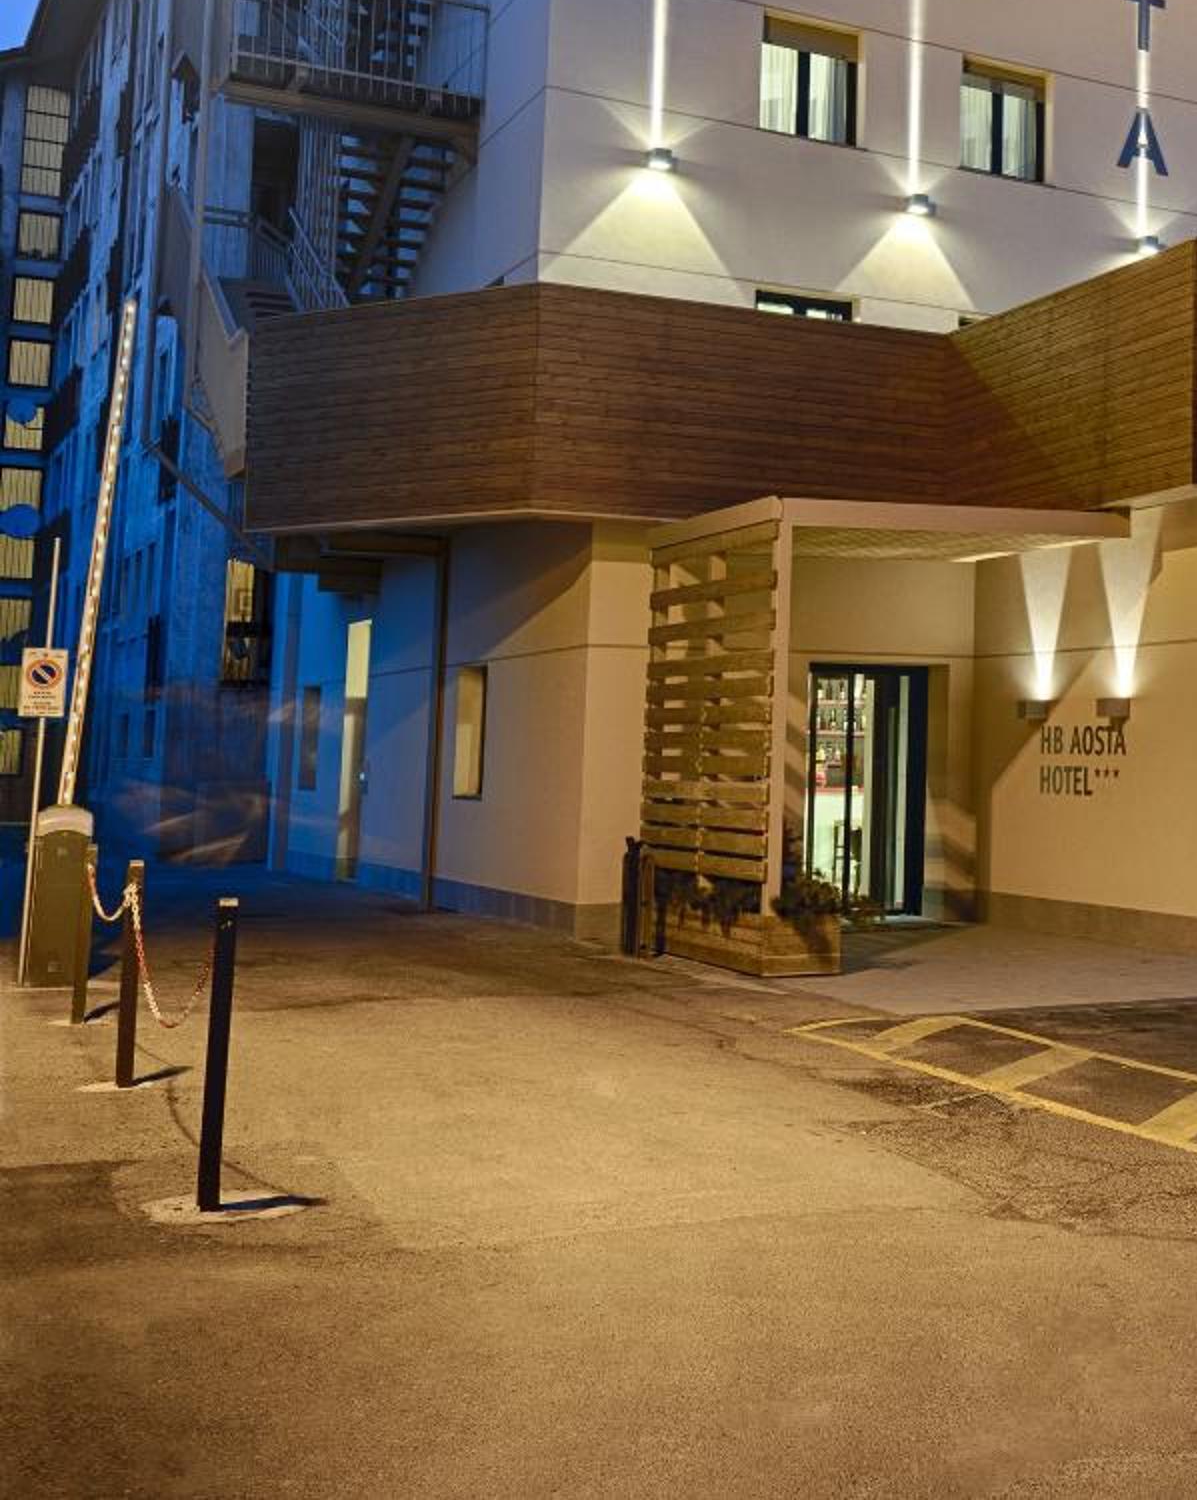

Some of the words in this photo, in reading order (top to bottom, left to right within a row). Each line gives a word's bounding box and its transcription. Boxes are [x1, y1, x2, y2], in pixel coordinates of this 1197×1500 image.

[1040, 725, 1063, 755] HB
[1069, 725, 1127, 756] AOSTA
[1040, 764, 1093, 796] HOTEL
